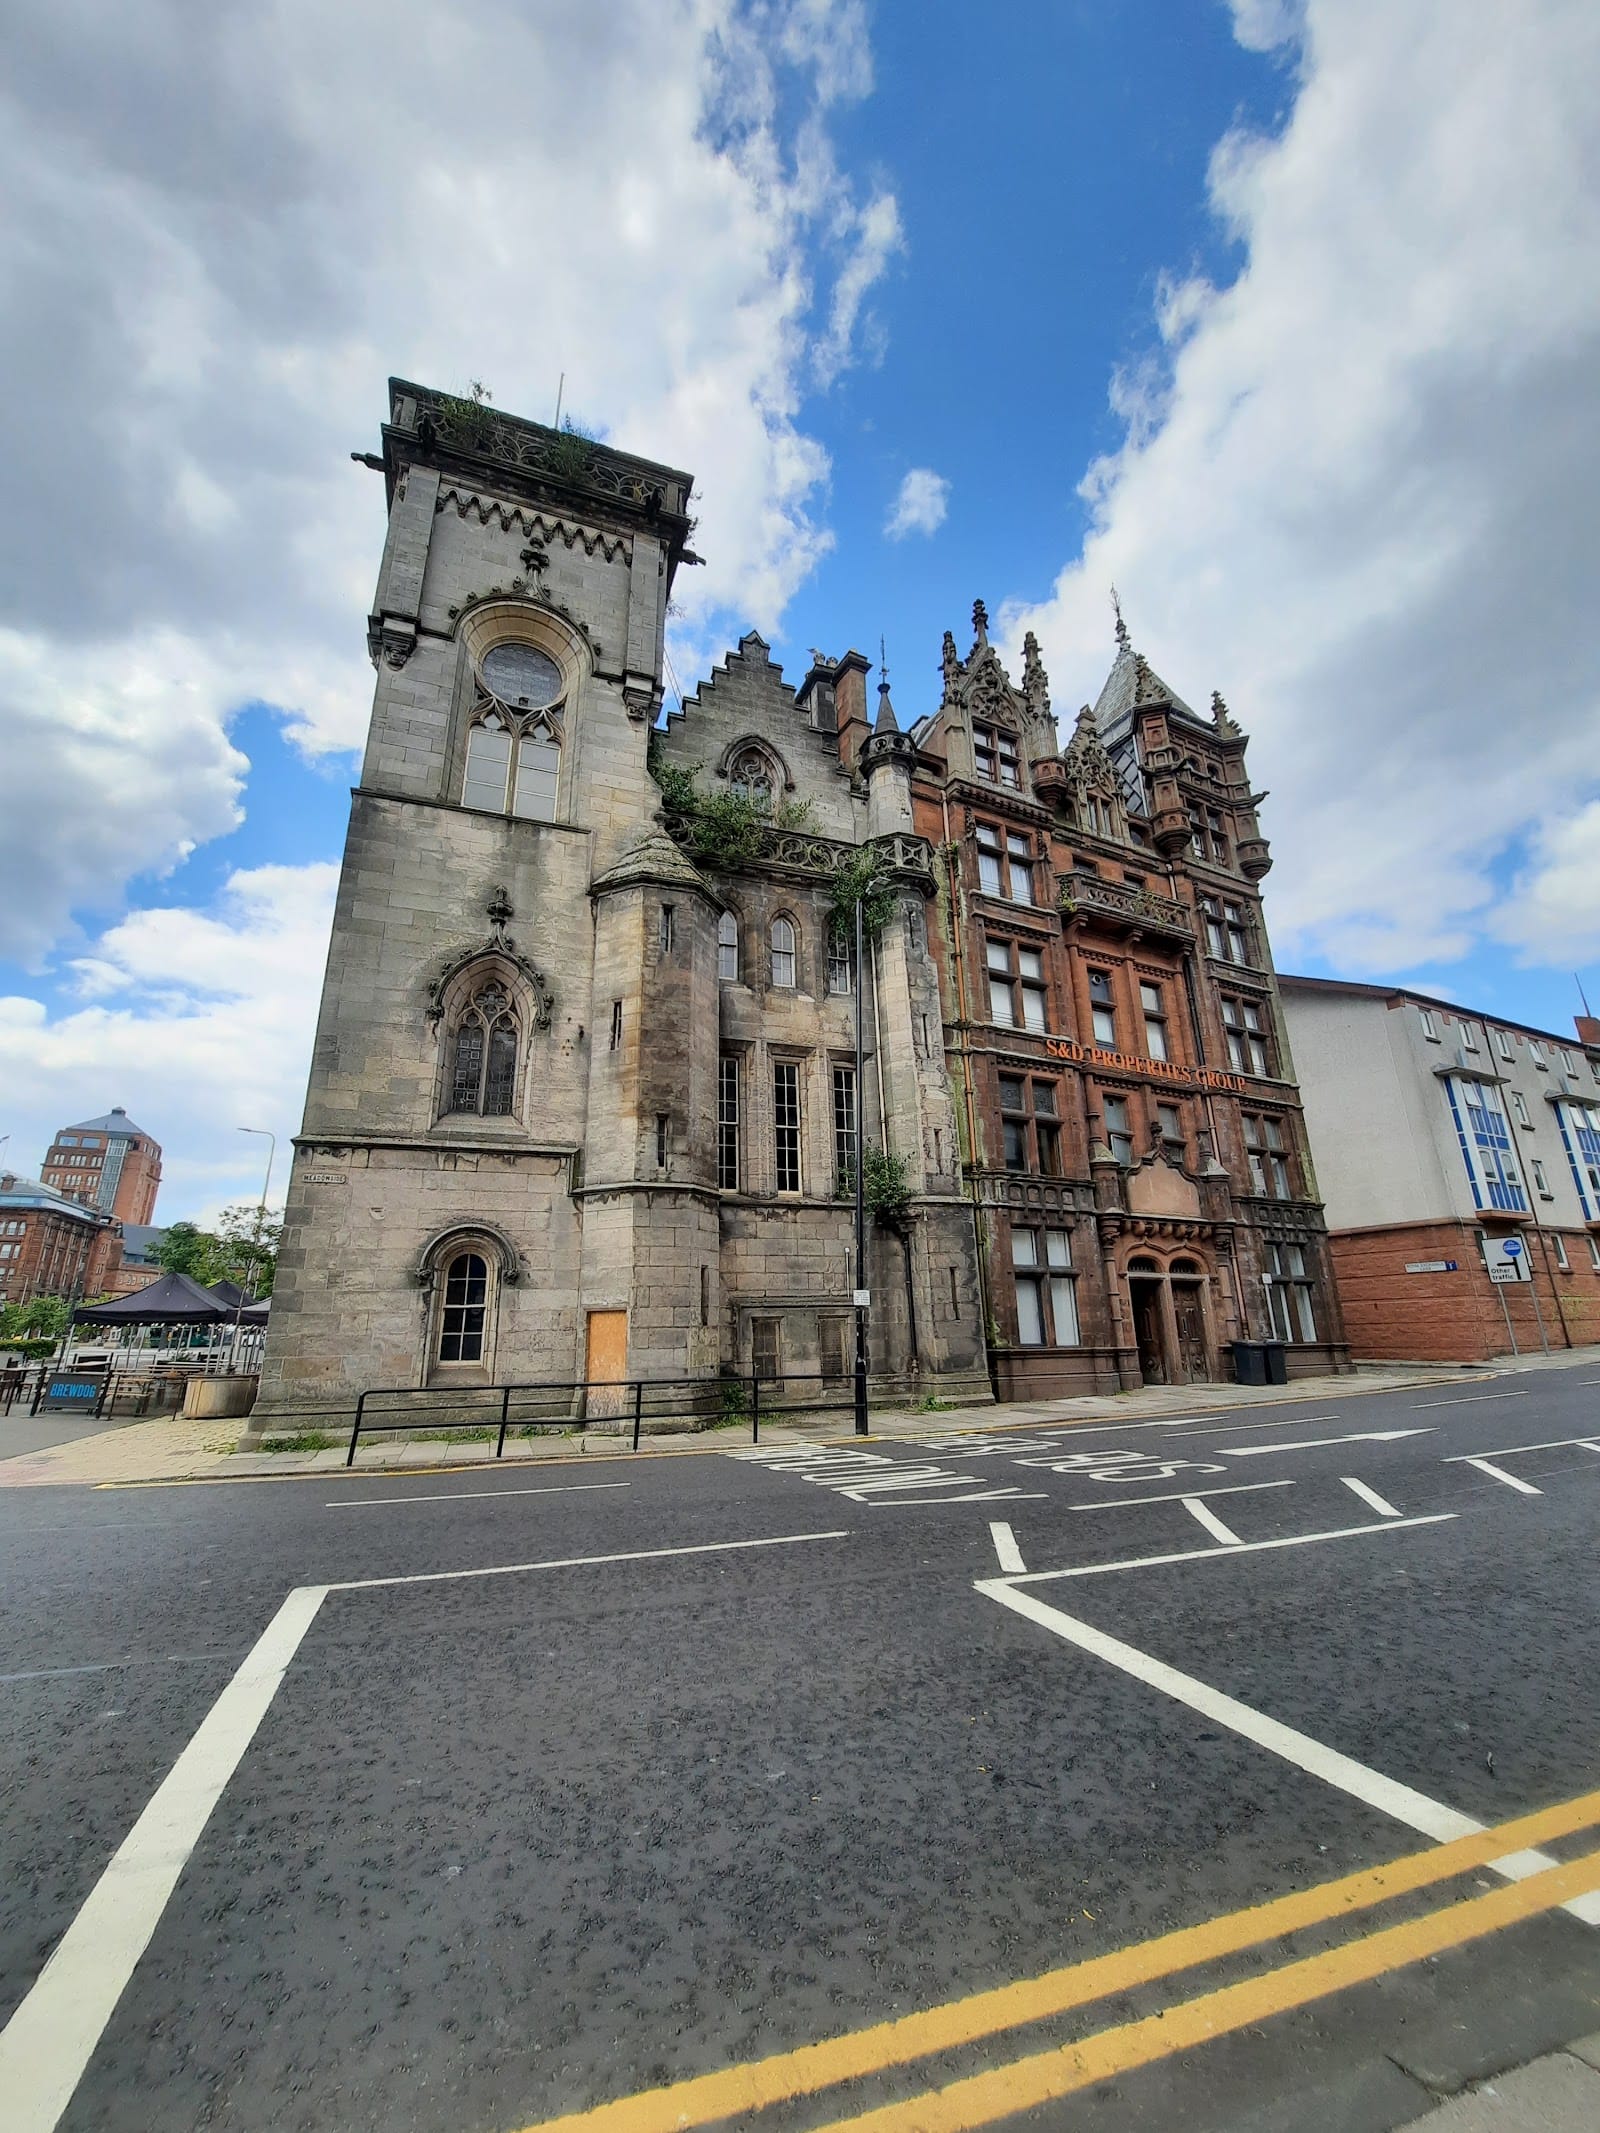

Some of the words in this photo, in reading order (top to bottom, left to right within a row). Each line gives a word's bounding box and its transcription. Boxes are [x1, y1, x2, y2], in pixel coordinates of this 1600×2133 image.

[1046, 1039, 1084, 1061] S&D
[1091, 1048, 1192, 1083] PROPERTIES
[1195, 1068, 1247, 1092] GROUP
[50, 1383, 97, 1398] BREWDOG
[1010, 1450, 1228, 1482] BUS
[801, 1465, 1049, 1506] ONLY
